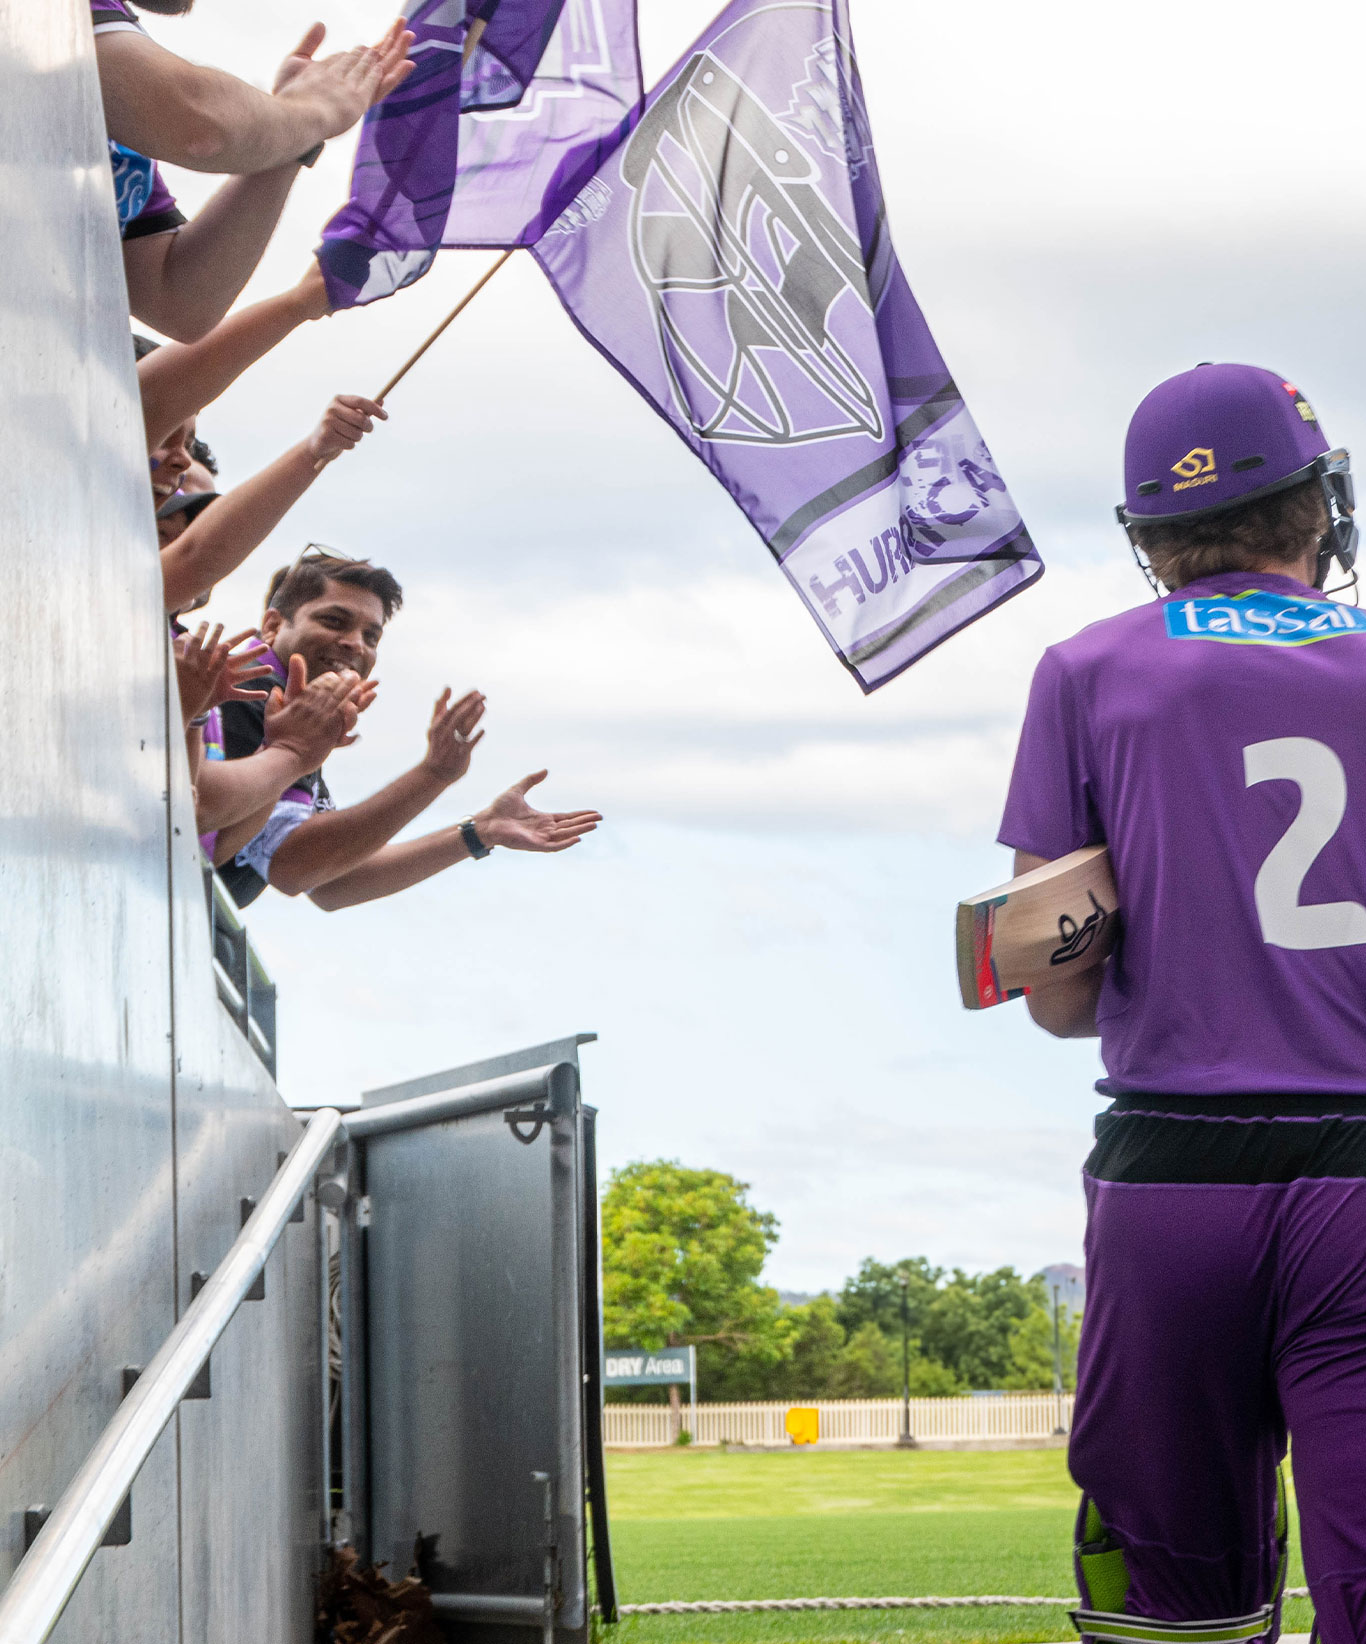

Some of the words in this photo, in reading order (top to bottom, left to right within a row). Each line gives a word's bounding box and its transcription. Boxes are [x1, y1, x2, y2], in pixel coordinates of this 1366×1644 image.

[1179, 600, 1357, 636] tassal
[606, 1357, 643, 1378] DRY
[645, 1356, 684, 1376] Area
